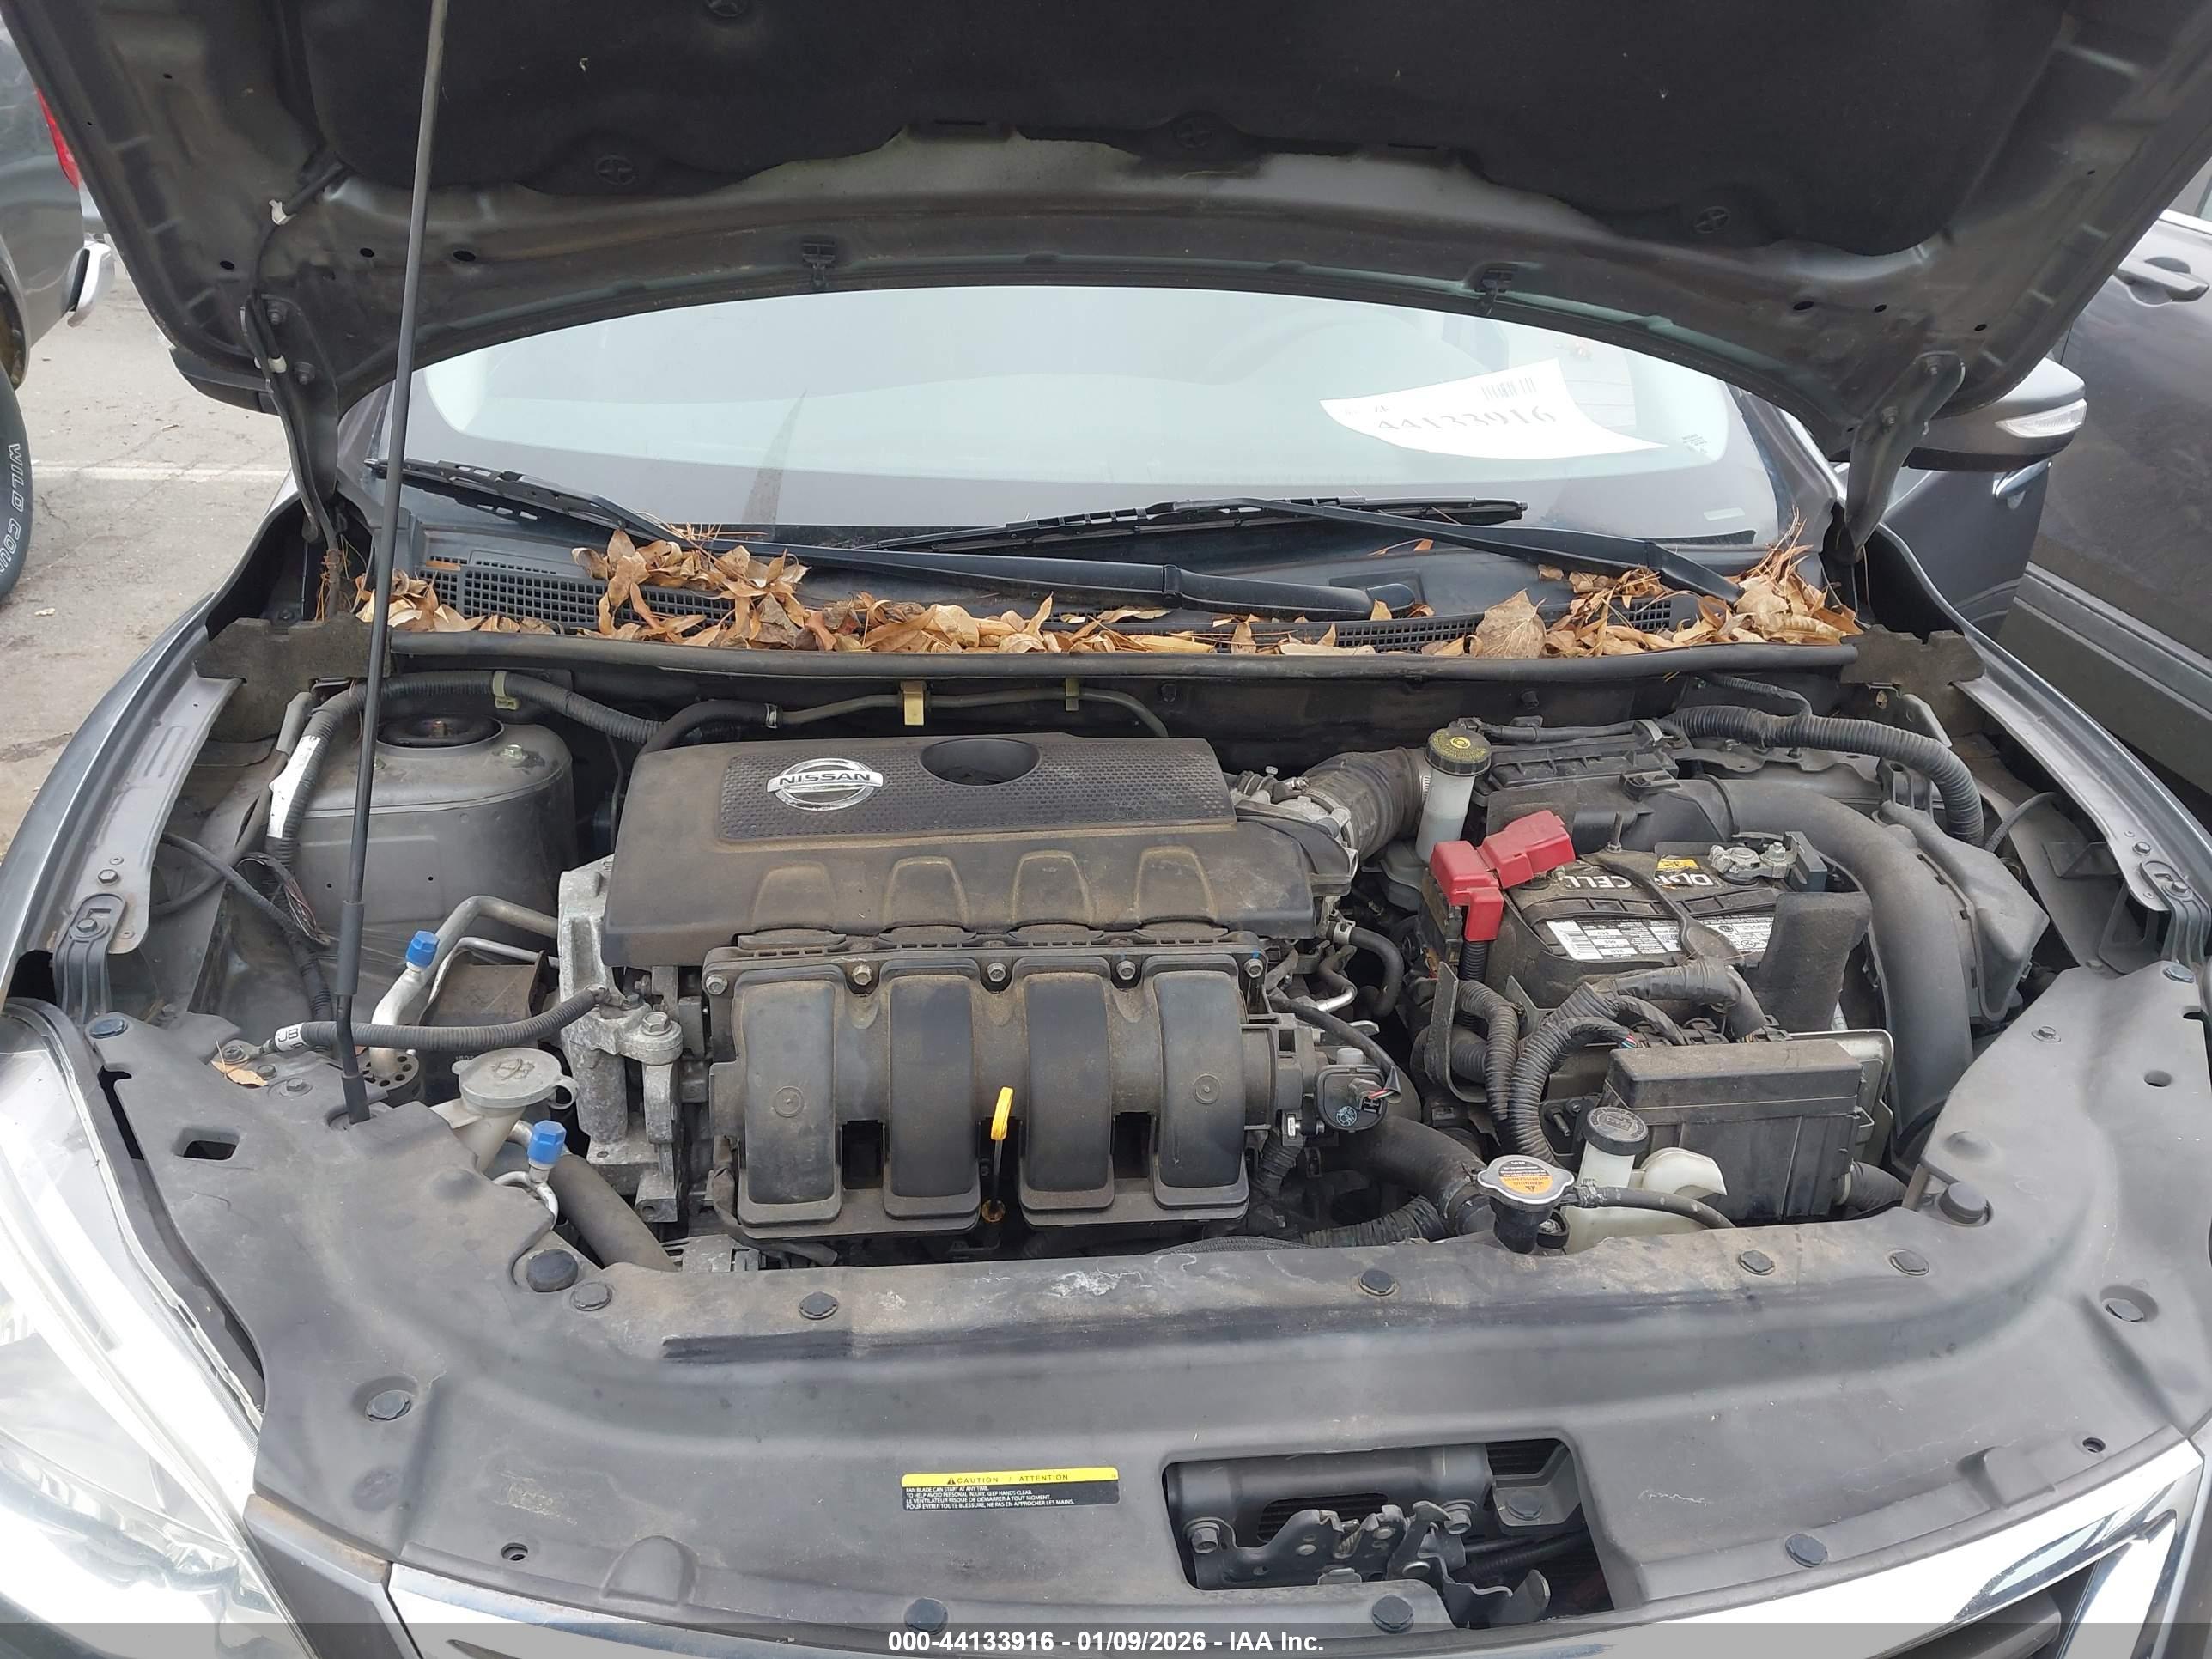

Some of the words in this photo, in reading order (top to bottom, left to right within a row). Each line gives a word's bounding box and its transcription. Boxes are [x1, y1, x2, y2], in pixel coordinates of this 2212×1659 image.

[8, 443, 24, 513] WILD
[0, 517, 21, 576] COU
[779, 772, 871, 786] NISSAN
[277, 1028, 299, 1042] JB
